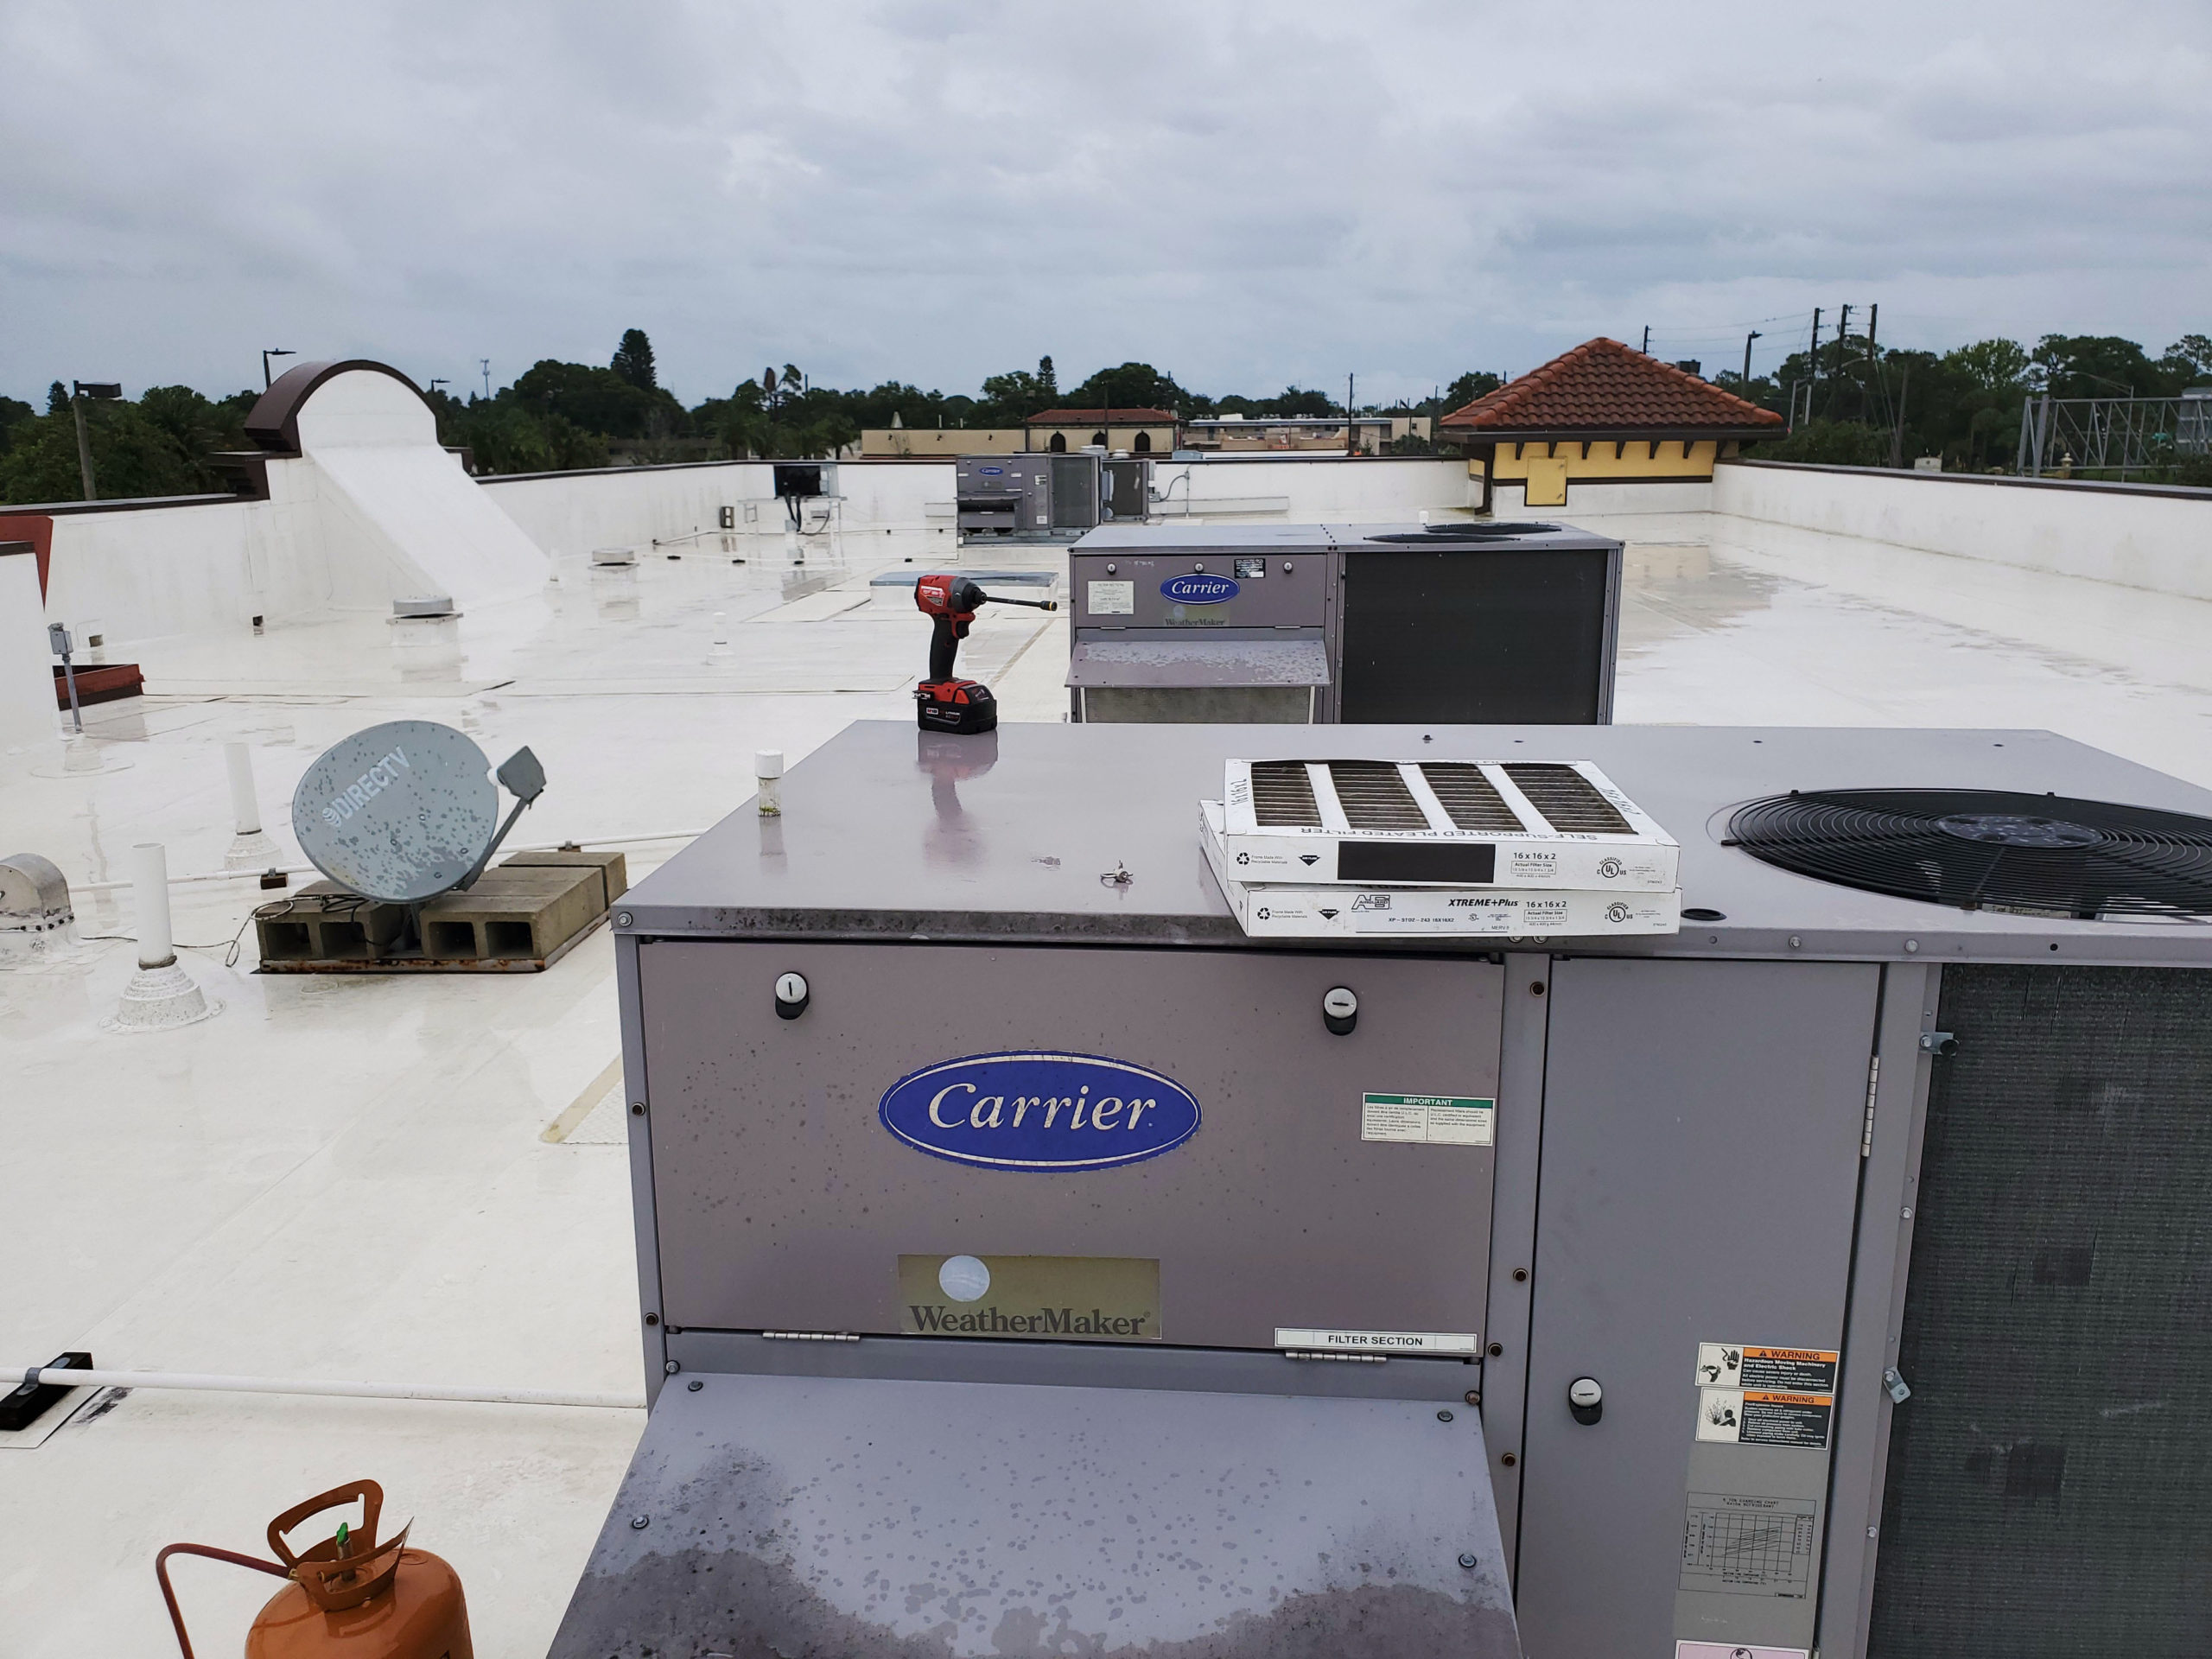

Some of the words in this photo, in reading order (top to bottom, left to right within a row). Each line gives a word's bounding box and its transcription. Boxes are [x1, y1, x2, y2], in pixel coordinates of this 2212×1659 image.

[1172, 581, 1229, 594] Carrier
[331, 747, 410, 820] DIRECTV
[1443, 830, 1598, 840] SELF-SUPPORTED
[1599, 857, 1623, 866] CLASSIFIED
[928, 1083, 1156, 1130] Carrier
[1403, 1097, 1452, 1106] IMPORTANT
[1328, 1335, 1368, 1344] FILTER
[1371, 1336, 1423, 1345] SECTION
[1771, 1351, 1820, 1360] WARNING
[1773, 1395, 1814, 1403] WARNING
